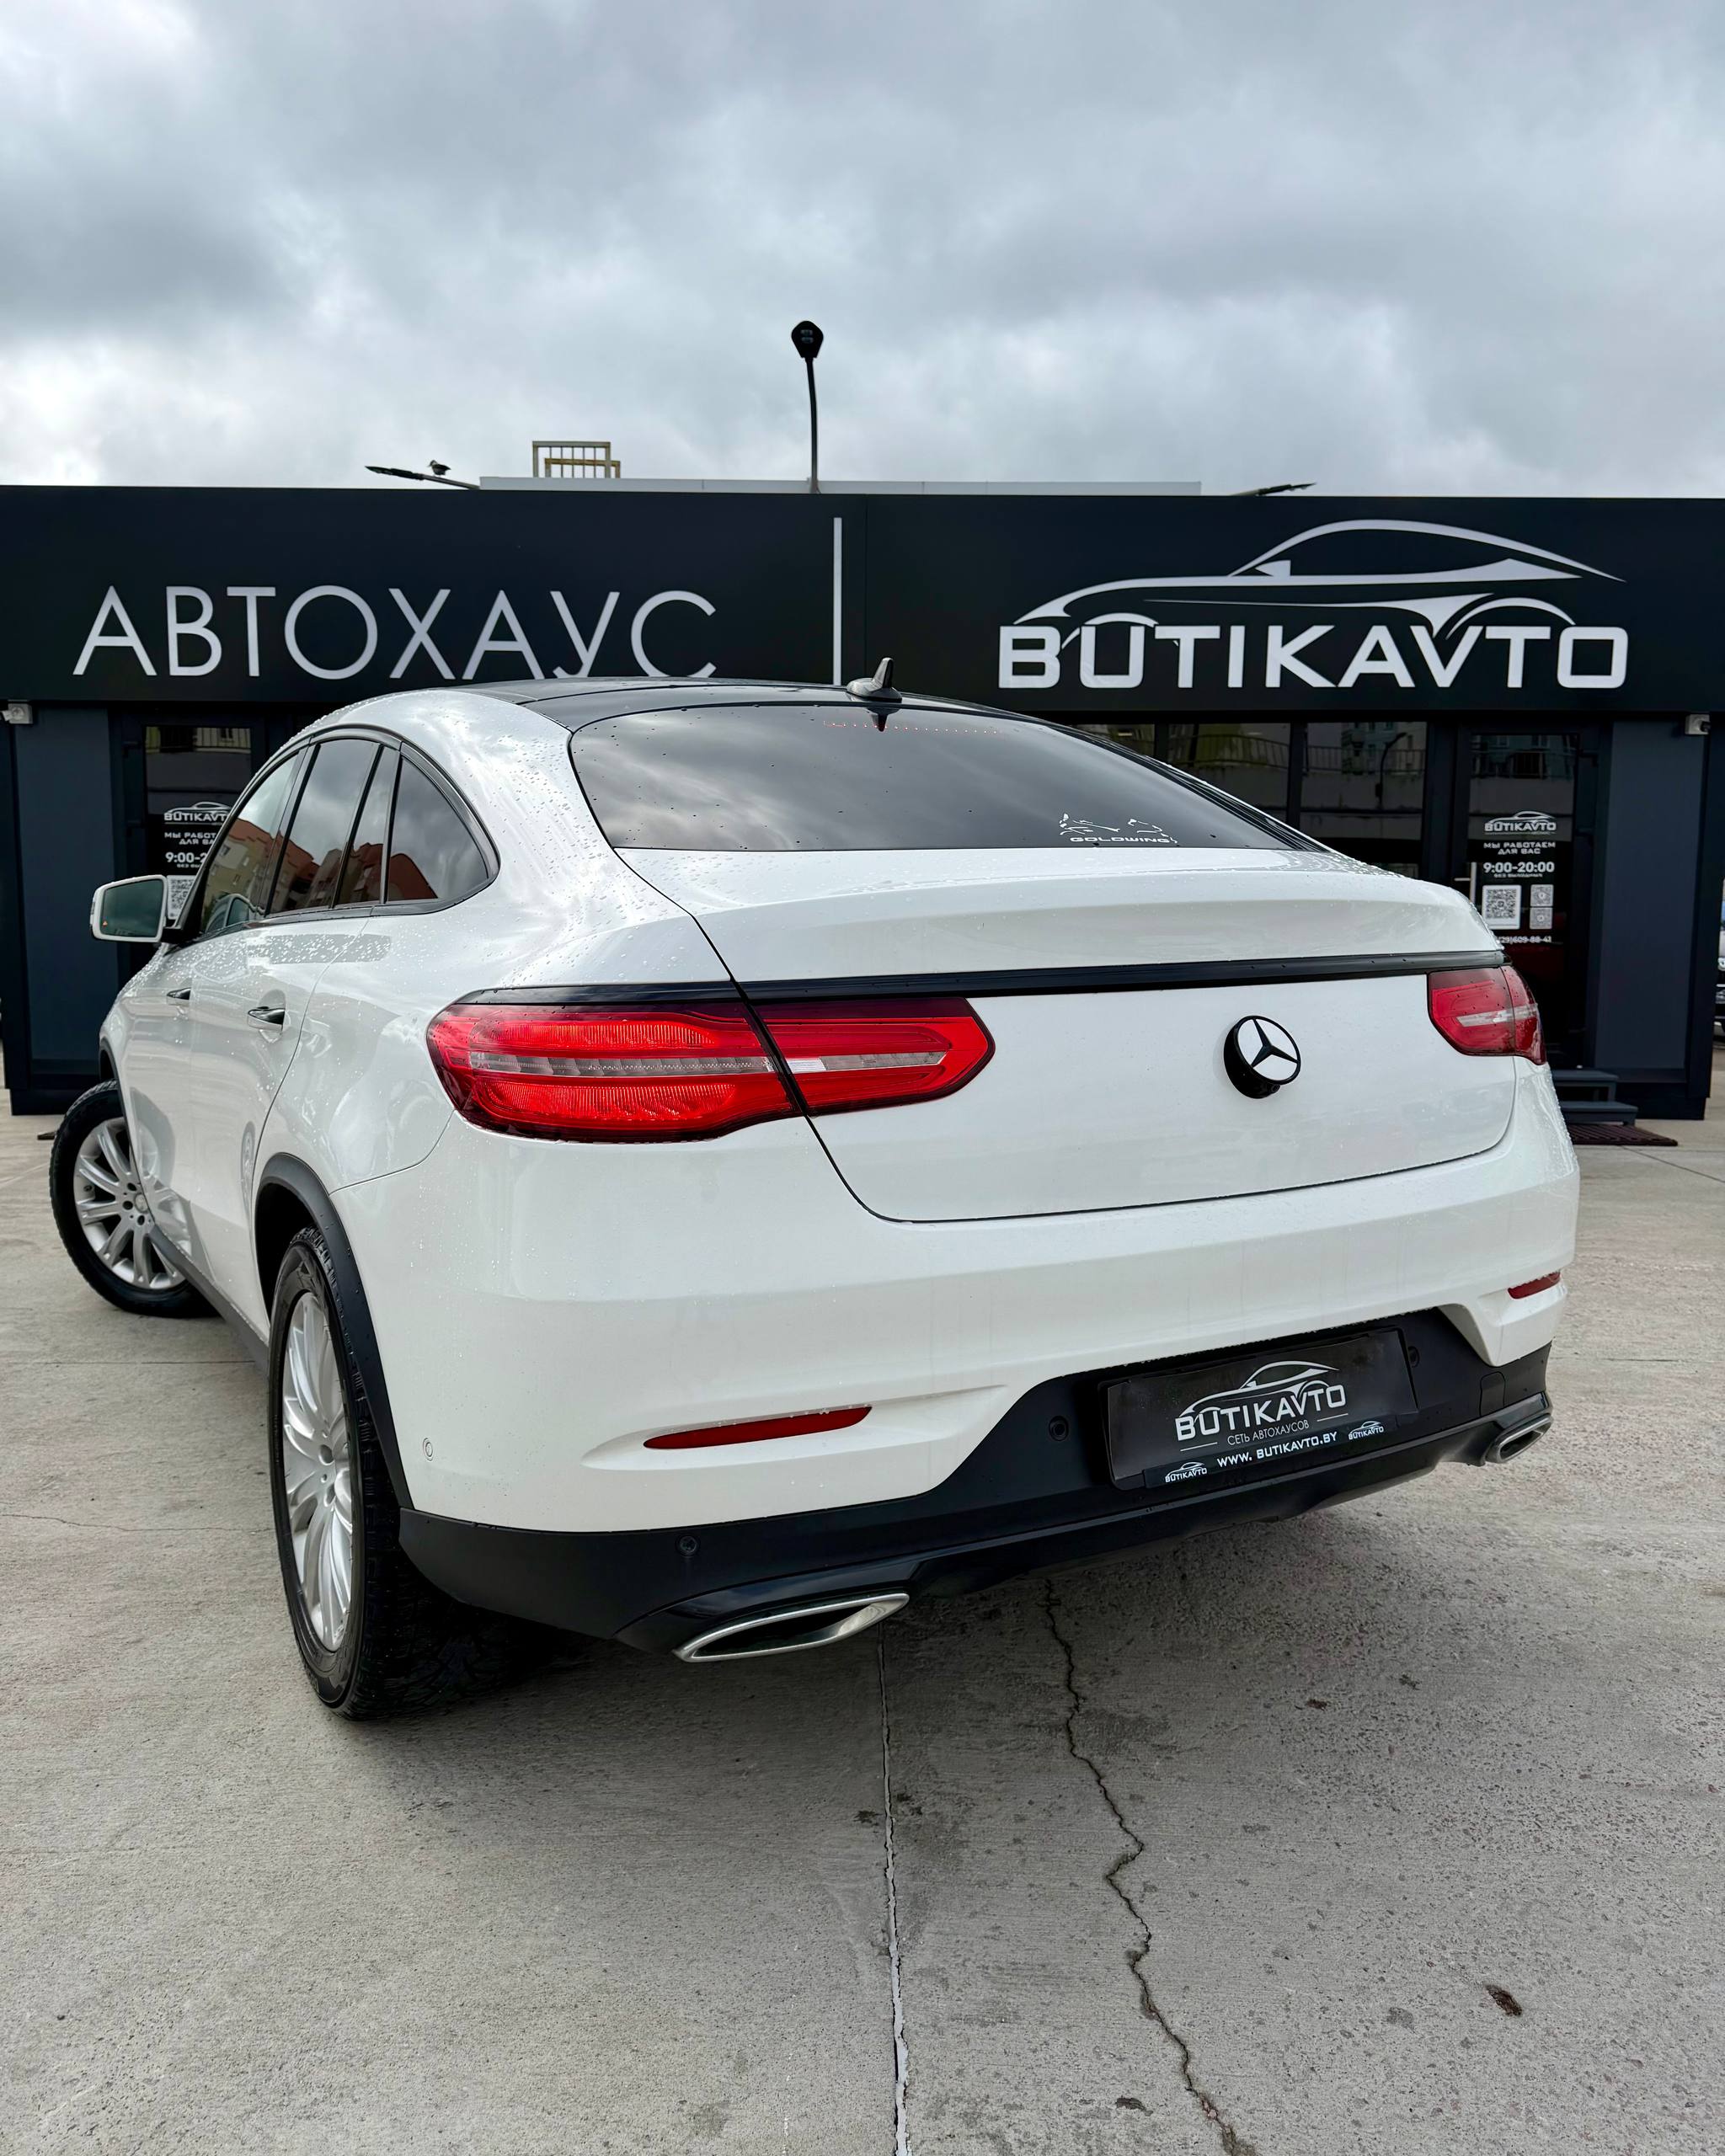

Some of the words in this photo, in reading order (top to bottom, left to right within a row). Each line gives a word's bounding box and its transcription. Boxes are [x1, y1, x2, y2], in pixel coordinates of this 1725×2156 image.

[72, 584, 718, 680] АВТОХАУС
[998, 623, 1628, 689] BUTIKAVTO
[163, 811, 228, 821] BUTIKAVT
[1484, 822, 1557, 831] BUTIKAVTO
[165, 851, 208, 863] 9:00-2
[1482, 861, 1555, 873] 9:00-20:00
[1175, 1385, 1346, 1440] BUTIKAVTO
[1227, 1434, 1250, 1446] СЕТЬ
[1252, 1419, 1310, 1442] АВТОХАУСОВ
[1348, 1425, 1385, 1440] BUTIKAVTO
[1216, 1451, 1252, 1468] WWW.
[1256, 1431, 1338, 1460] BUTIKAVTO.BY
[1165, 1467, 1208, 1483] BUTIKAVTO
